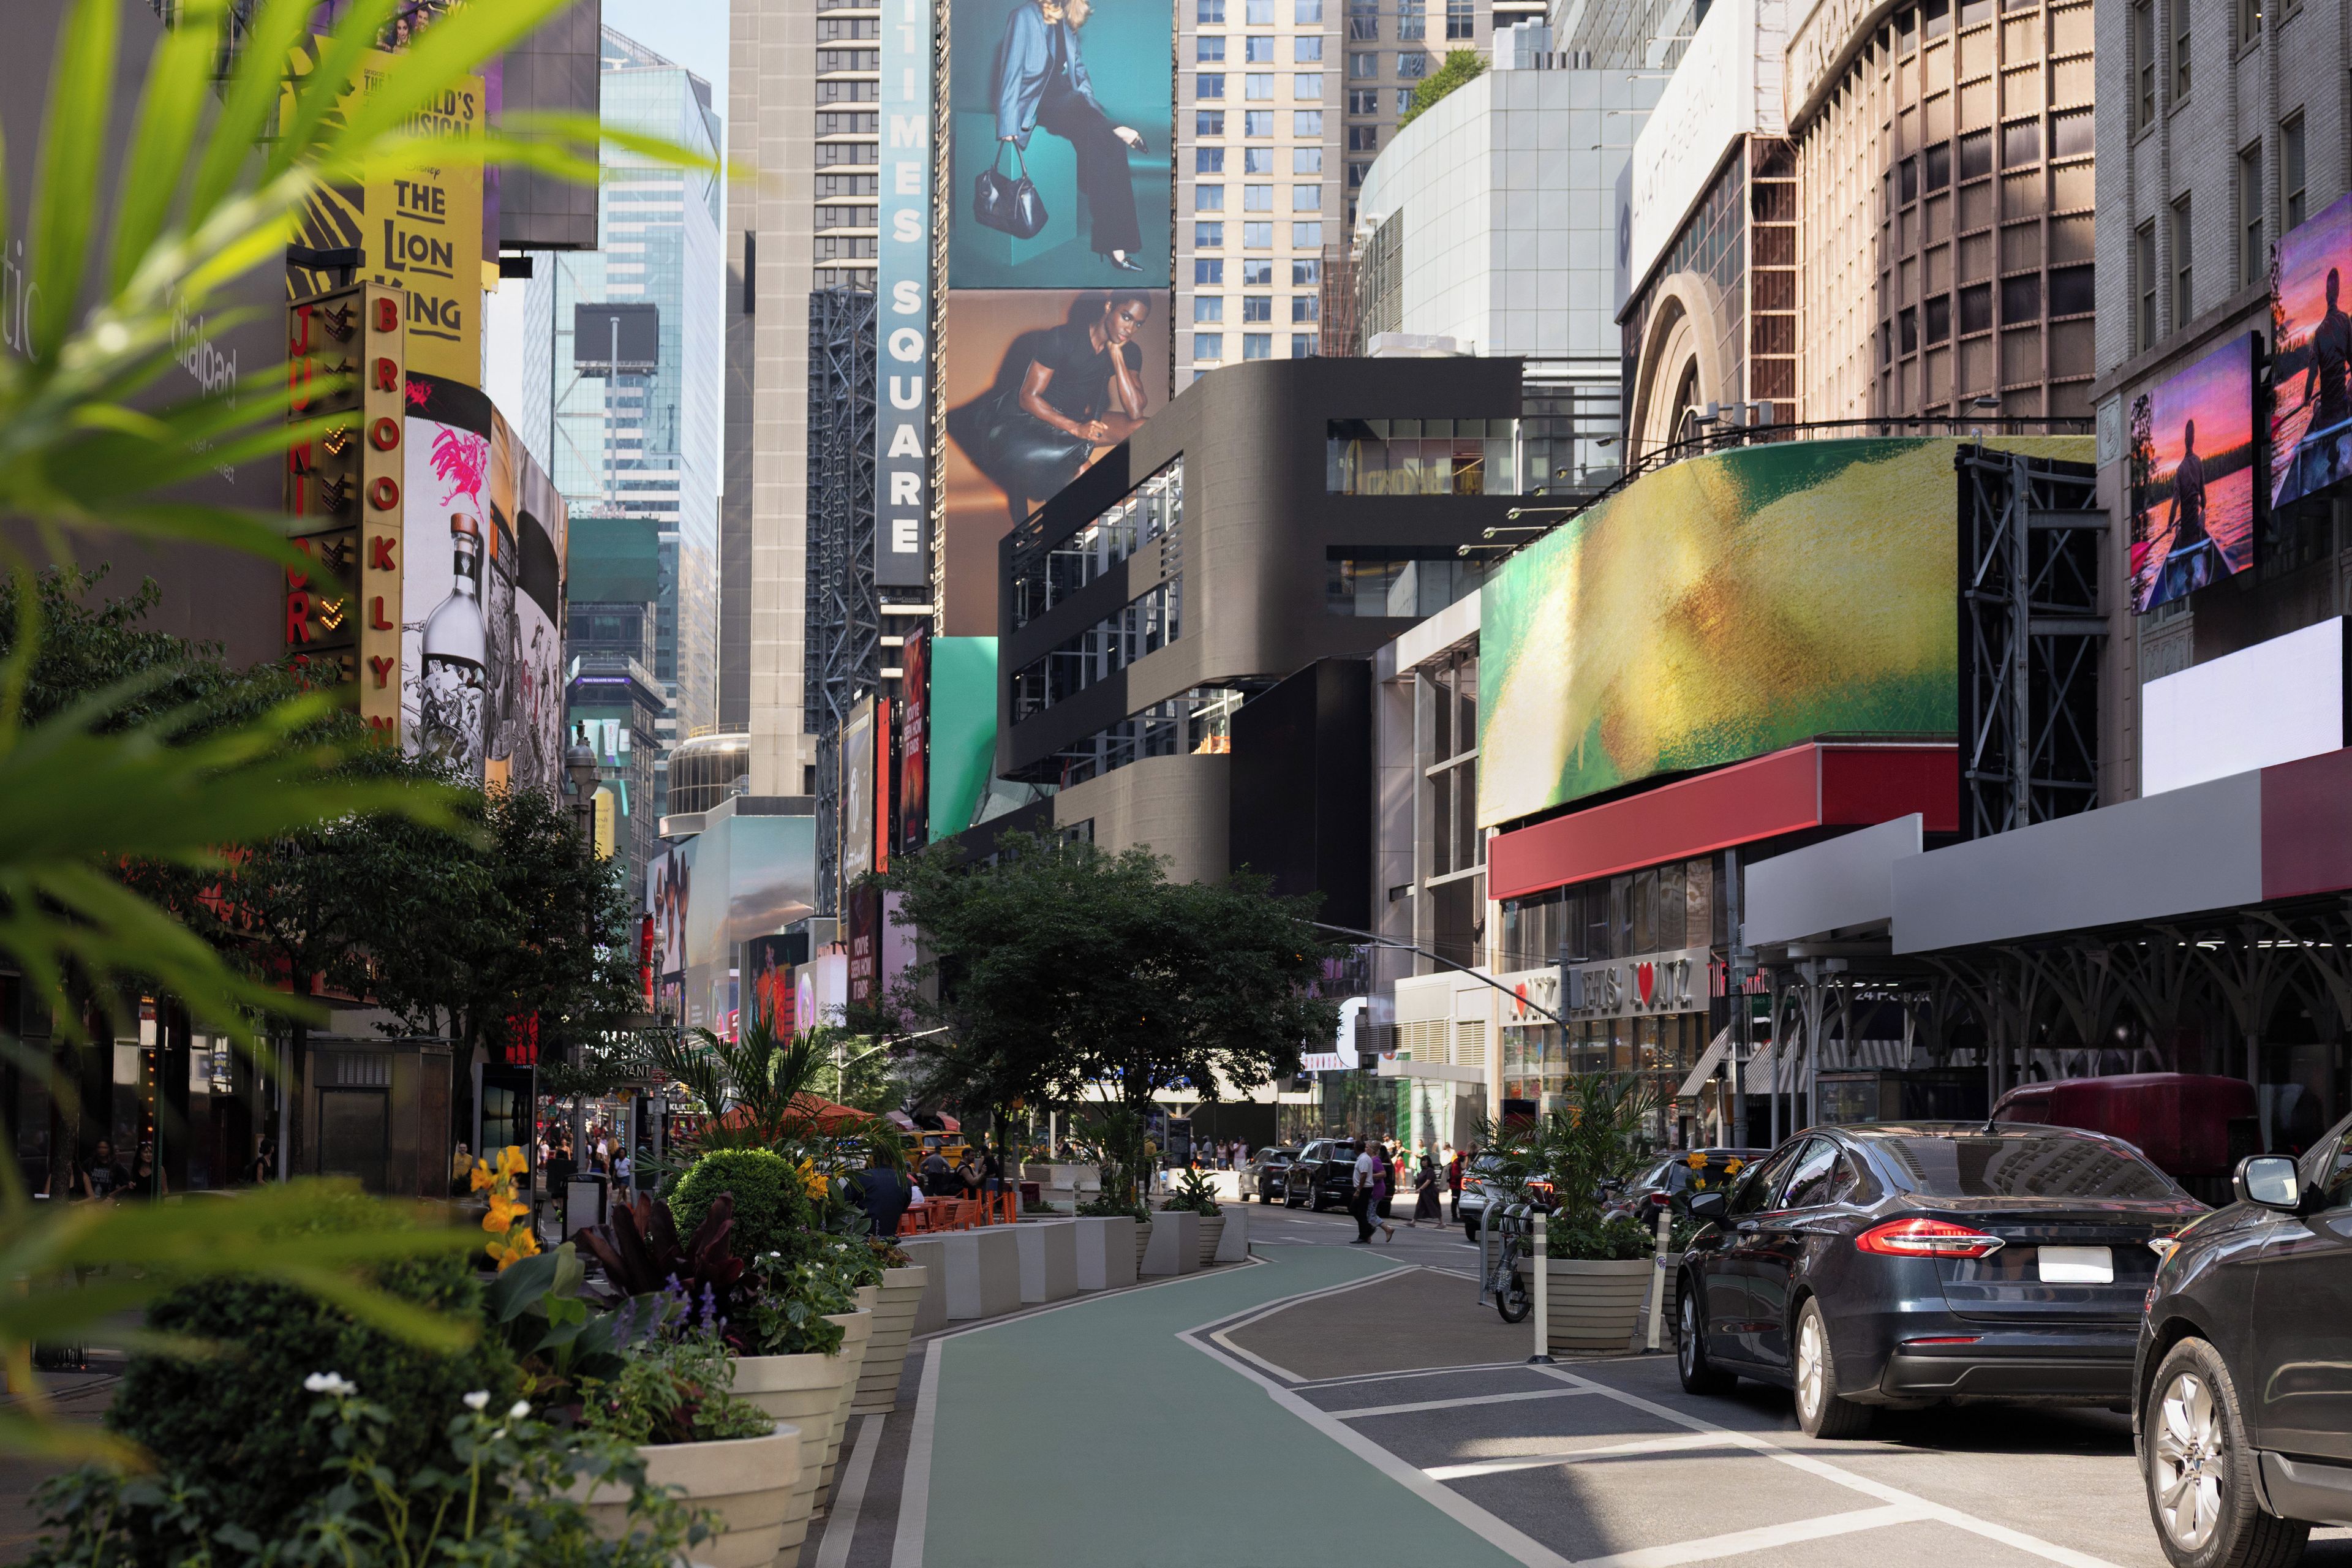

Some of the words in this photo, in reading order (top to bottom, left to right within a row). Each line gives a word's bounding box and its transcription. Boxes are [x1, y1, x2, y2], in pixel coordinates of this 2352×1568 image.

[394, 179, 445, 215] THE
[384, 219, 453, 272] LION
[375, 274, 461, 330] ING
[172, 296, 236, 411] dialpad
[821, 400, 833, 477] EAGLE
[887, 280, 925, 553] SQUARE
[370, 297, 400, 747] BROOKLYN
[833, 430, 845, 587] OUTFITTERS
[820, 486, 832, 627] AMERICAN
[904, 723, 913, 742] SEEN
[913, 717, 922, 735] HOW
[910, 736, 919, 756] ENDS
[851, 960, 861, 979] SEEN
[861, 957, 872, 976] HOW
[854, 935, 869, 957] YOU'VE
[853, 981, 858, 1000] IT
[858, 980, 868, 1000] ENDS
[1656, 957, 1692, 1006] NY
